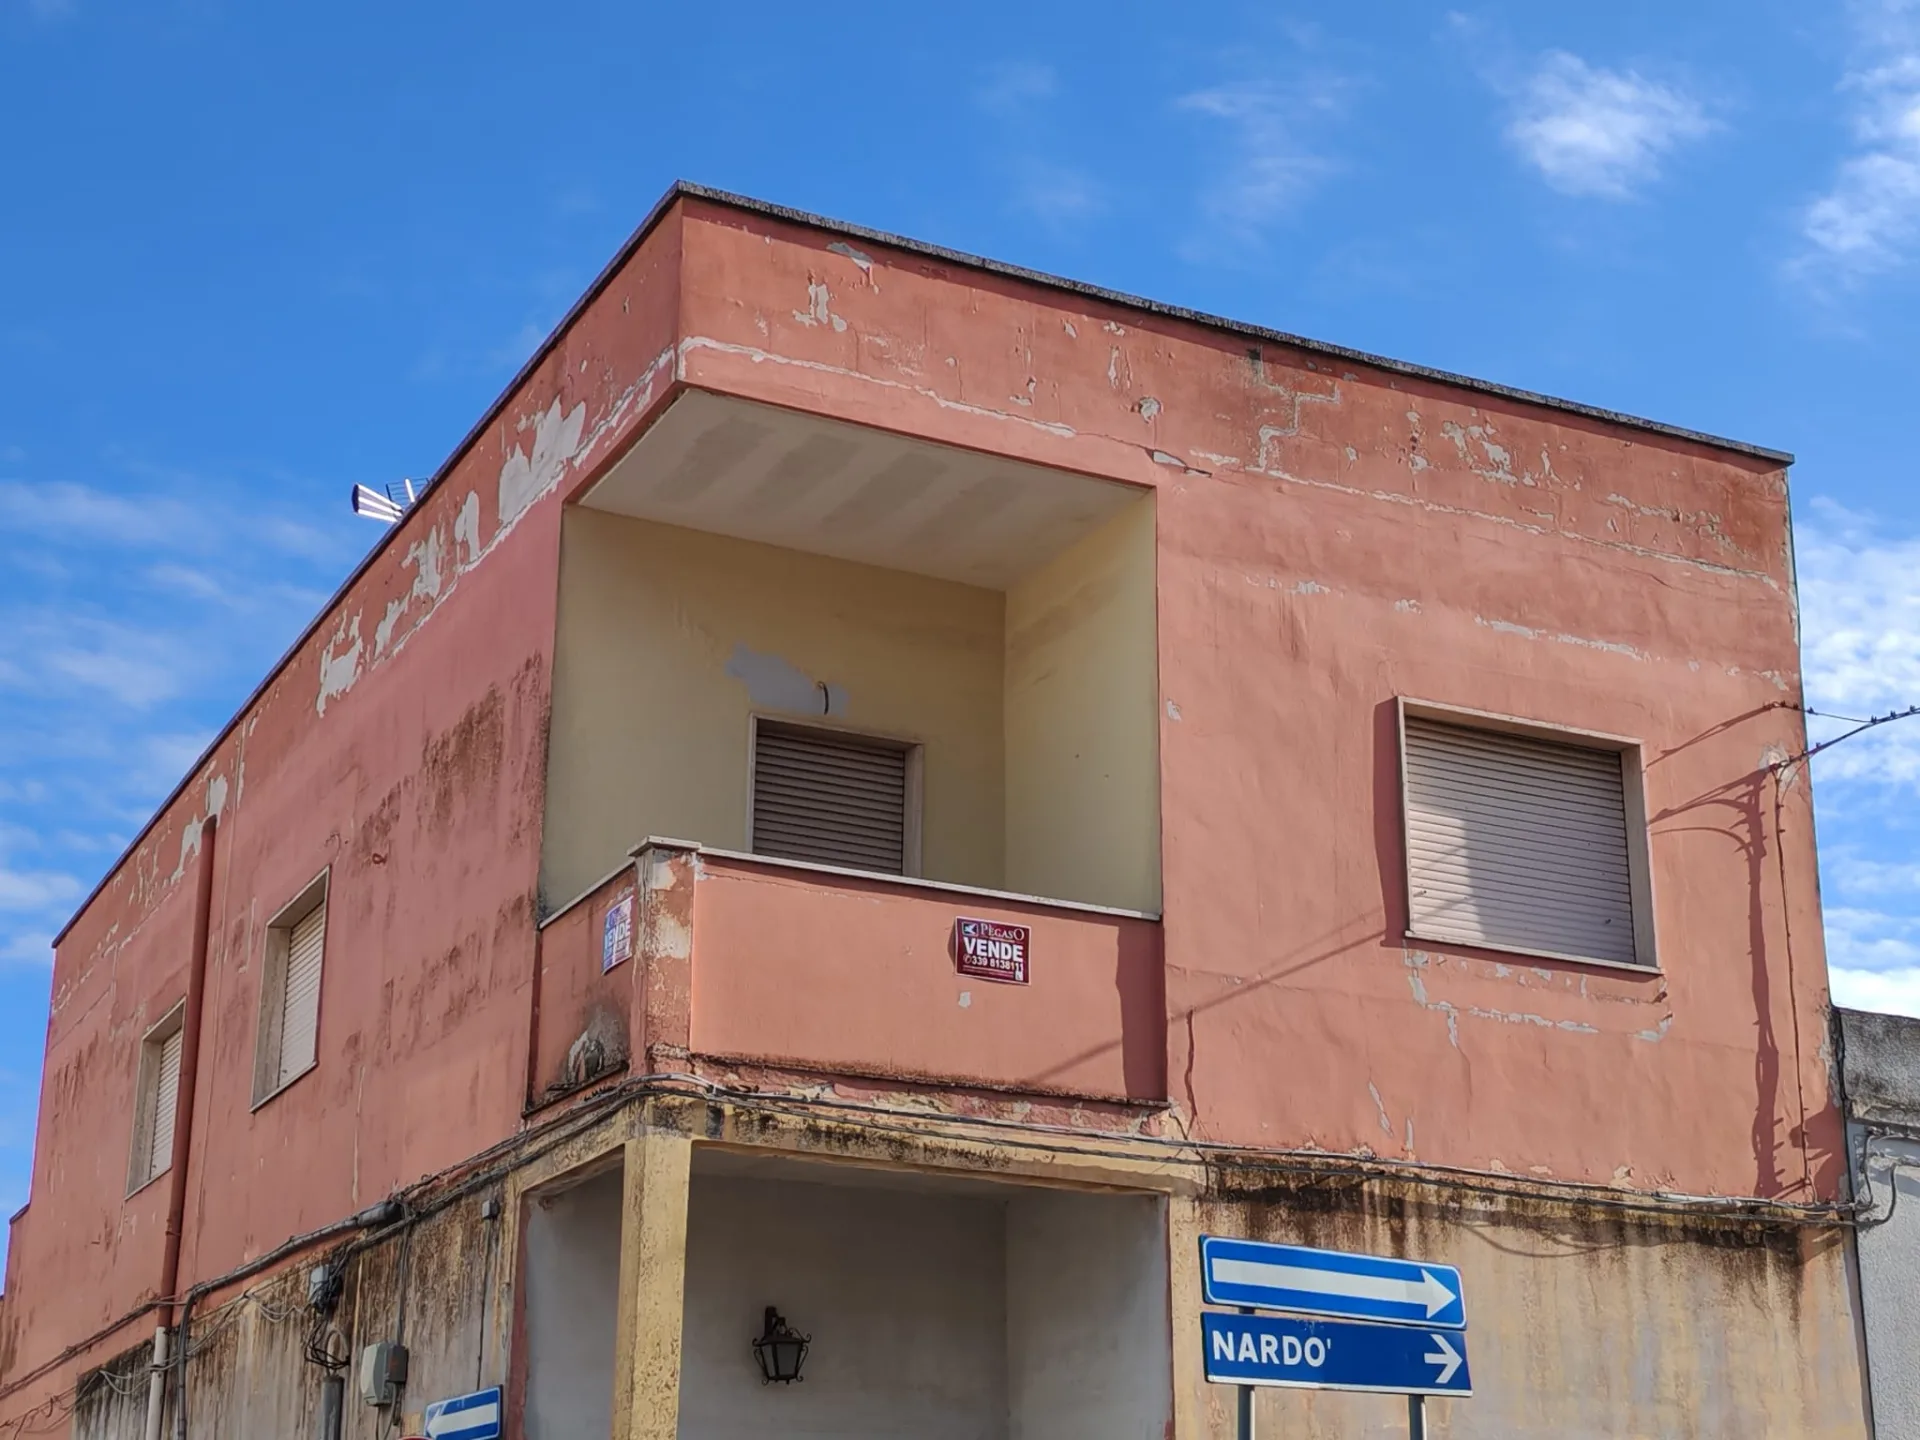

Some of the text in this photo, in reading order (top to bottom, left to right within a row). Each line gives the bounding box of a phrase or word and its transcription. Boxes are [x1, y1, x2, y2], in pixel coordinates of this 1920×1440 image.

[963, 937, 1024, 962] VENDE
[972, 955, 988, 966] 339
[1212, 1330, 1332, 1367] NARDO'
